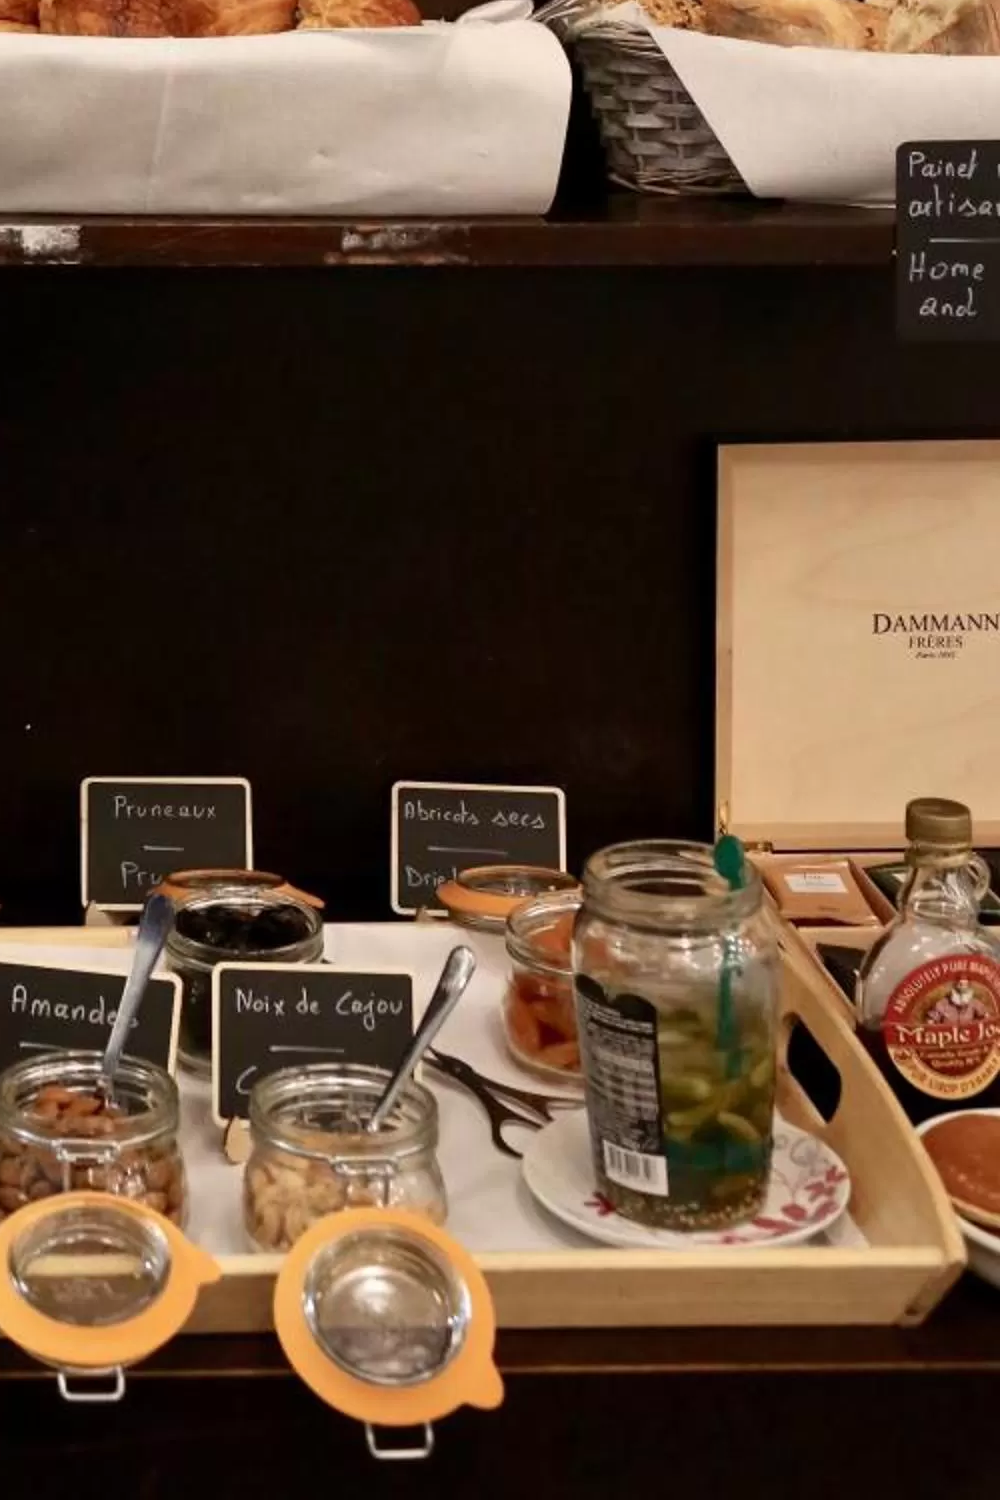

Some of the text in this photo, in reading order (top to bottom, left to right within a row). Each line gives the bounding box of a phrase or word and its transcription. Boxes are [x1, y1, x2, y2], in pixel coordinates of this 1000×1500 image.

[909, 184, 1000, 217] artisa
[909, 252, 985, 283] Home
[919, 287, 977, 317] and
[872, 613, 1000, 635] DAMMANN
[114, 795, 217, 820] Pruneaux
[404, 800, 546, 830] Abricots secs
[121, 861, 163, 889] Pru
[235, 987, 403, 1031] Noix de Cajou
[895, 1024, 971, 1049] Maple
